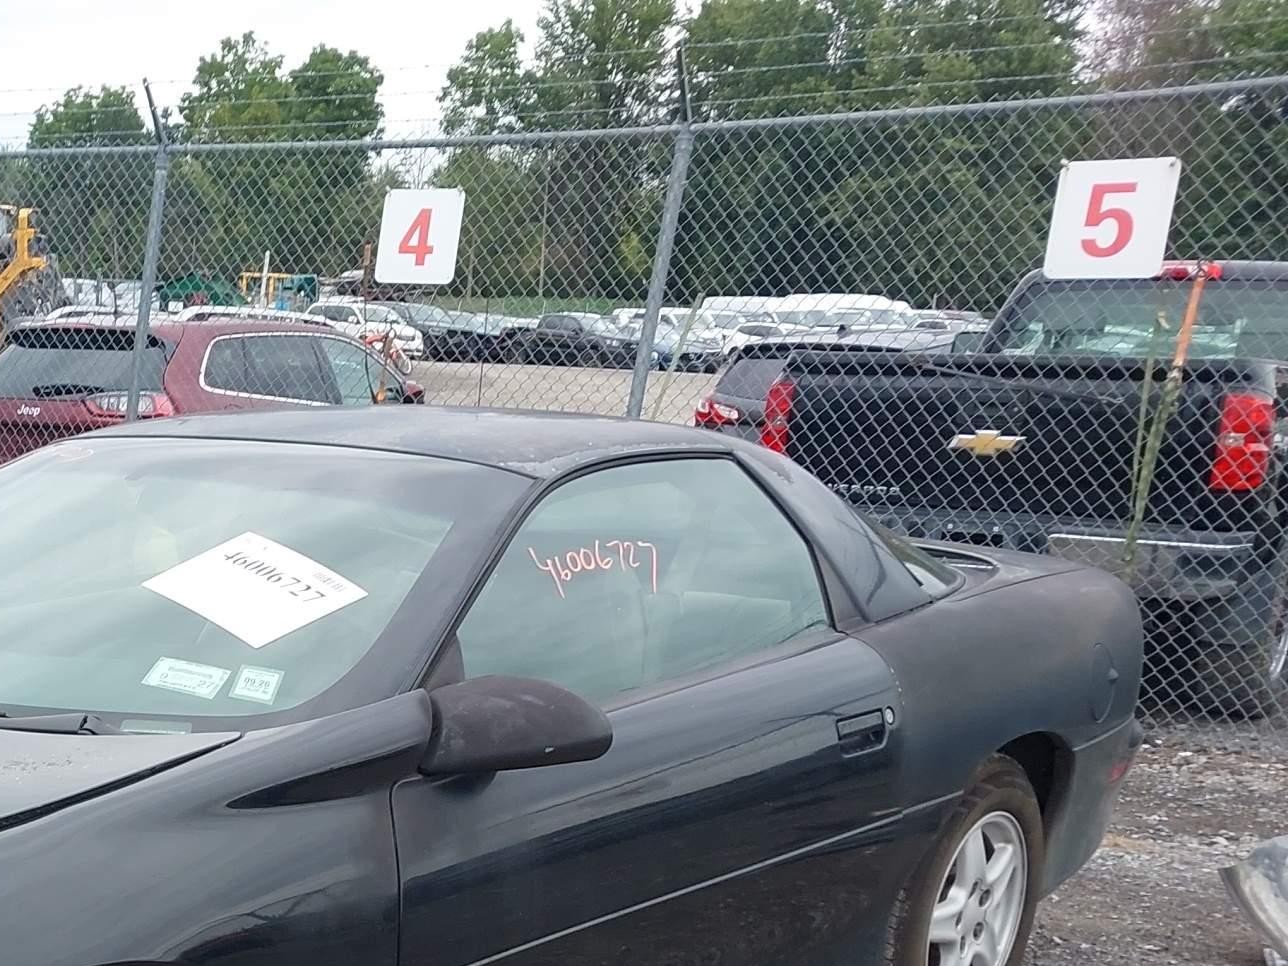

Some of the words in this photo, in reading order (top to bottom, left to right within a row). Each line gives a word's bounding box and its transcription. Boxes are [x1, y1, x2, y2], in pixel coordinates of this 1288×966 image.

[398, 207, 434, 266] 4
[1080, 182, 1139, 258] 5
[17, 404, 40, 417] Jeep
[223, 551, 327, 602] 46006727
[528, 539, 657, 600] 46006727
